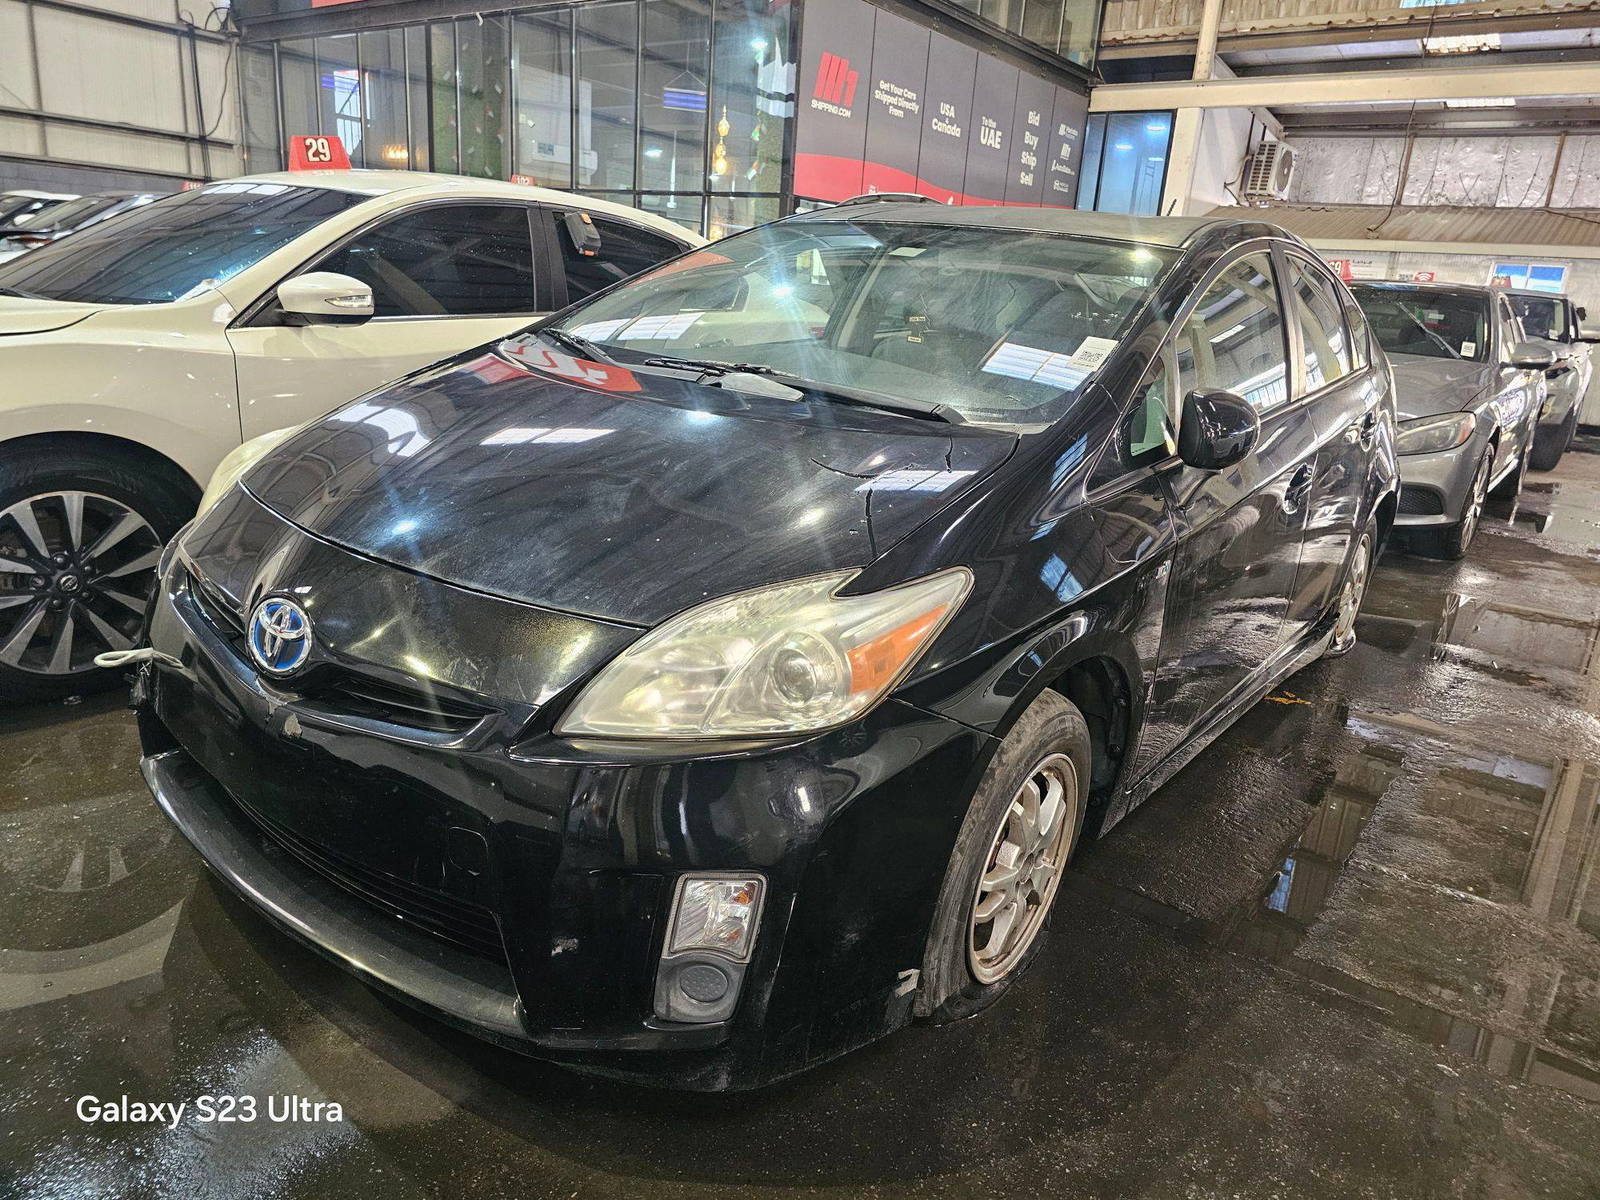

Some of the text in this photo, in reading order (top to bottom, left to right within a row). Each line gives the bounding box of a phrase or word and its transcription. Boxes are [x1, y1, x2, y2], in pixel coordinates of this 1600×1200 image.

[879, 80, 917, 100] Get Your Cars
[874, 89, 919, 114] Shipped Directly
[940, 102, 955, 118] USA
[888, 105, 904, 118] From
[1028, 111, 1040, 126] Bid
[932, 118, 961, 138] Canada
[980, 125, 1002, 150] UAE
[304, 137, 331, 162] 29
[1024, 131, 1039, 150] Buy
[1021, 151, 1037, 170] Ship
[1020, 171, 1034, 187] Sell
